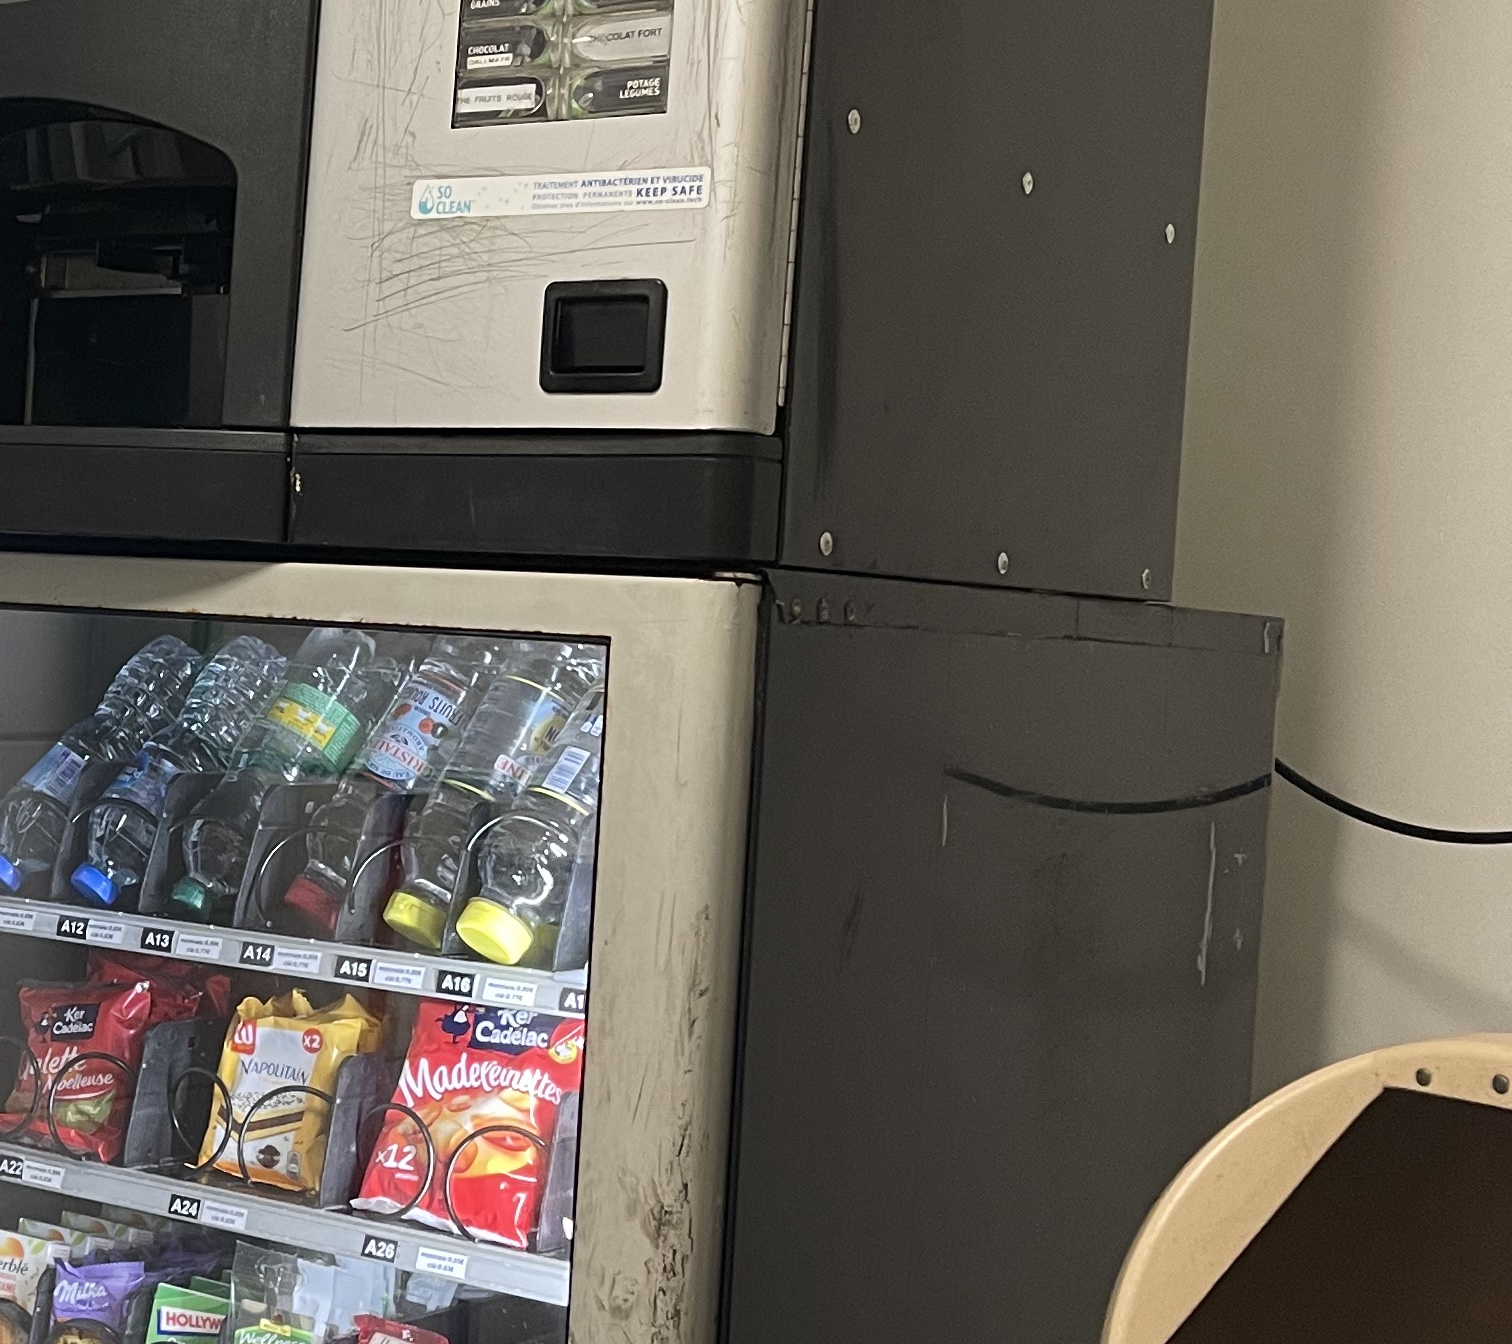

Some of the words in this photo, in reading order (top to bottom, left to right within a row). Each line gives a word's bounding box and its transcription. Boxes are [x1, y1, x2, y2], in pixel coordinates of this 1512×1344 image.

[470, 0, 500, 9] GRAINS
[638, 27, 662, 38] FORT
[468, 44, 510, 55] CHOCOLAT
[627, 78, 661, 89] POTAGE
[474, 94, 502, 104] FRUITS
[533, 181, 578, 190] TRAITEMENT
[650, 176, 660, 185] ET
[662, 174, 704, 184] VIRUCIDE
[437, 185, 452, 199] SO
[532, 193, 578, 201] PROTECTION
[636, 187, 667, 198] KEEP
[672, 185, 703, 196] SAFE
[436, 200, 471, 215] CLEAN
[61, 919, 85, 936] A12
[145, 932, 170, 948] A13
[243, 946, 271, 962] A14
[339, 960, 368, 976] A15
[442, 974, 471, 992] A16
[564, 992, 585, 1009] A1
[64, 1006, 85, 1022] Ker
[497, 1009, 538, 1027] Ker
[233, 1022, 254, 1045] LU
[396, 1051, 562, 1107] Madeleinettes
[0, 1159, 23, 1176] A22
[170, 1198, 199, 1217] A24
[365, 1238, 396, 1259] A26
[53, 1279, 108, 1305] Milka
[166, 1311, 223, 1330] HOLLYW
